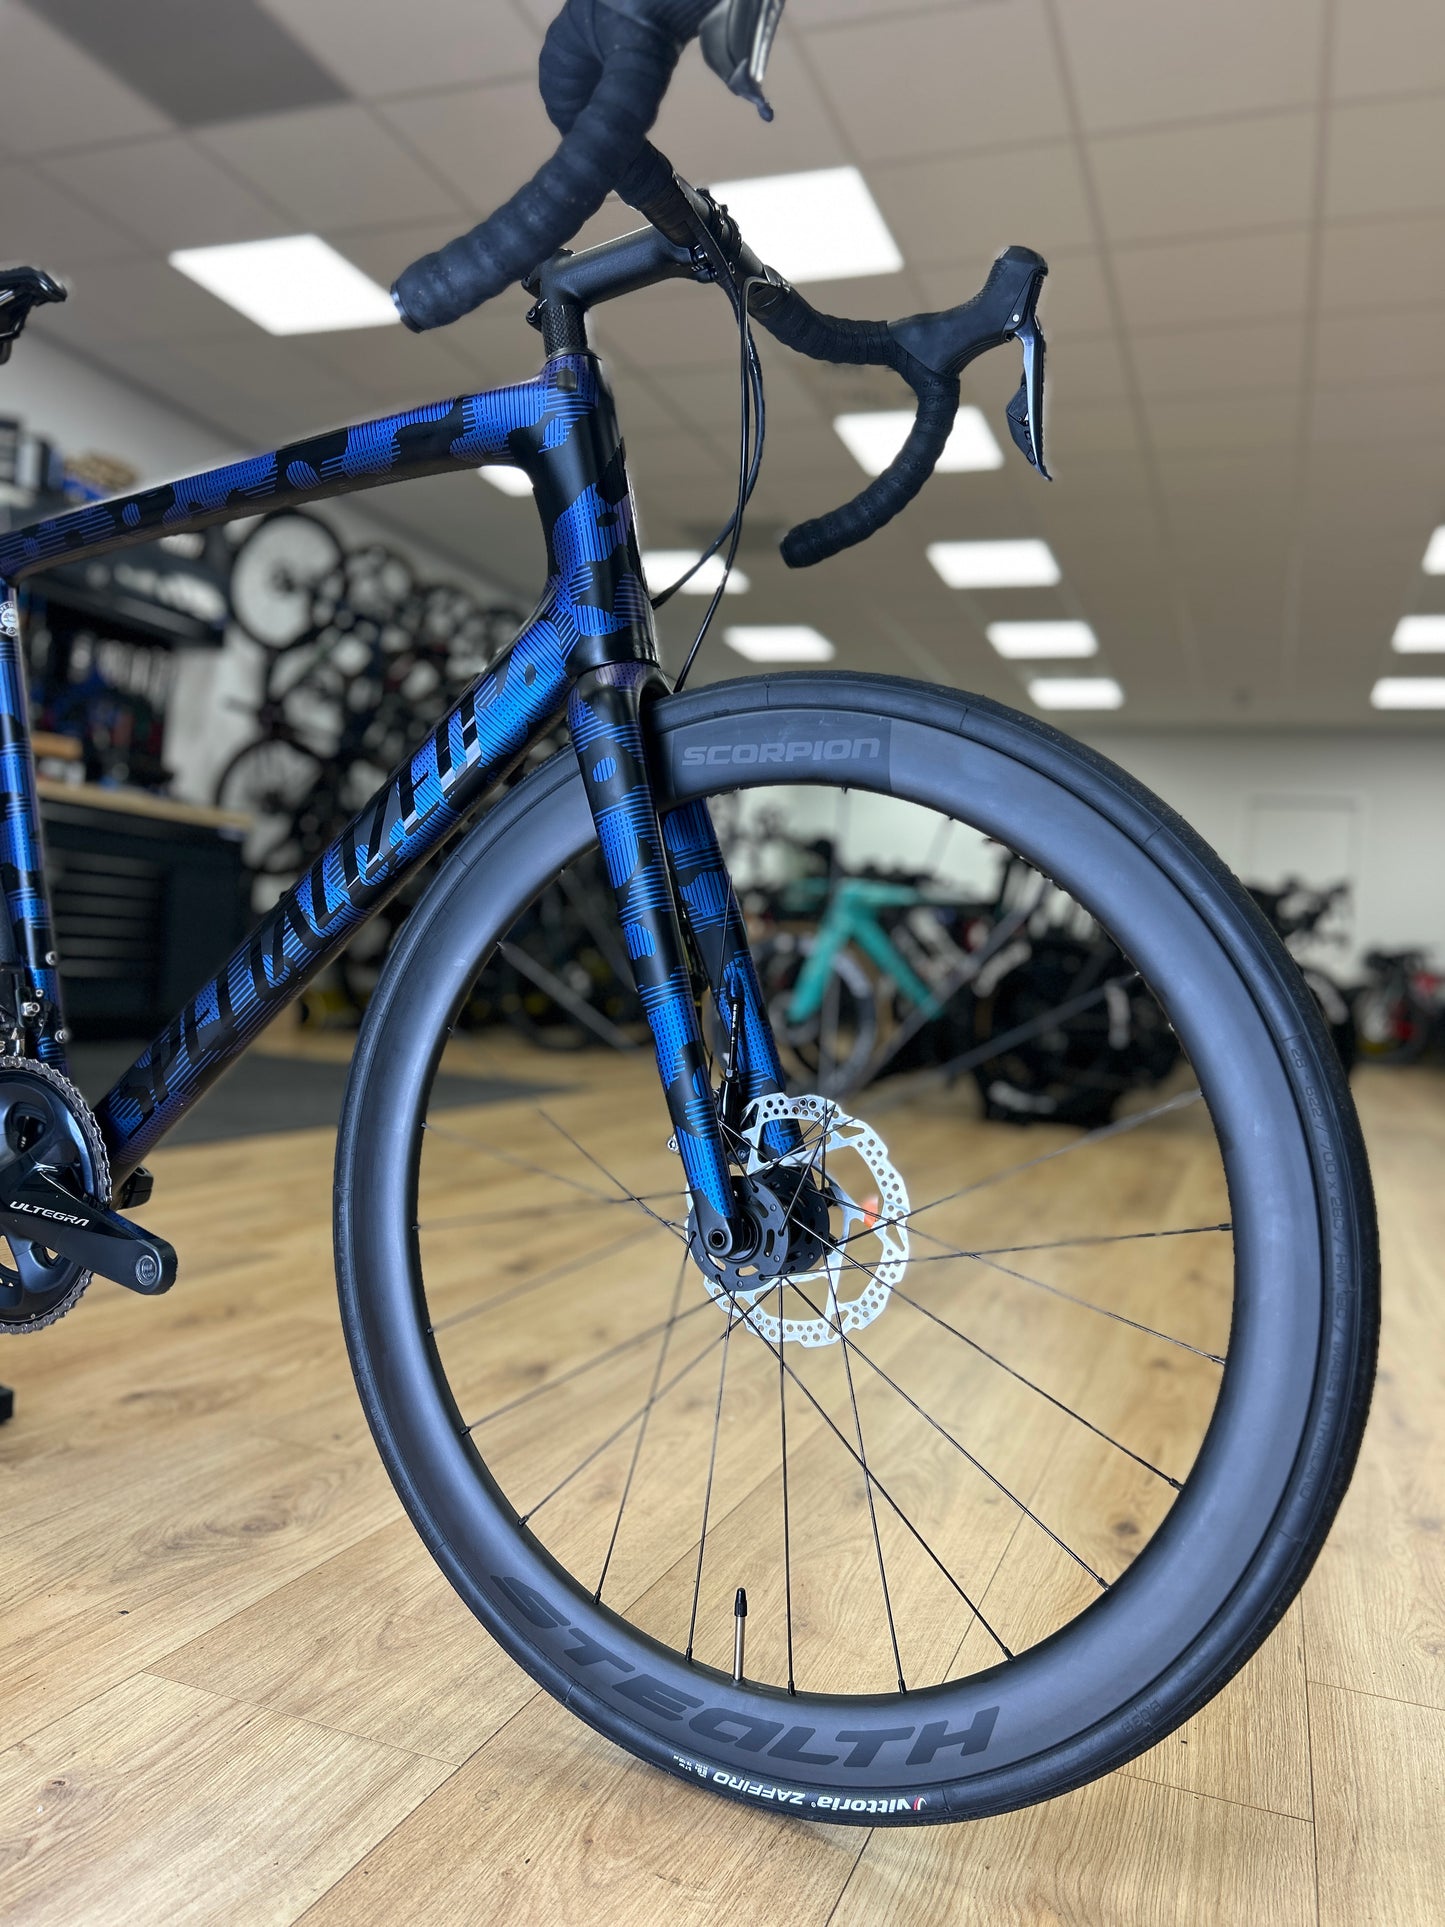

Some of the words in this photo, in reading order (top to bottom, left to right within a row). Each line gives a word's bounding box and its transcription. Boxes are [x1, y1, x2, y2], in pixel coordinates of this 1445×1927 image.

[681, 737, 881, 766] SCORPION
[1303, 1085, 1322, 1120] 622
[1319, 1141, 1338, 1175] 700
[10, 1200, 90, 1227] ULTEGRA
[1326, 1341, 1345, 1392] MADE
[1298, 1420, 1334, 1502] THAILAND
[489, 1574, 1000, 1768] STEALTH
[712, 1771, 806, 1806] ZAFFIRO
[816, 1795, 912, 1814] vittoria
